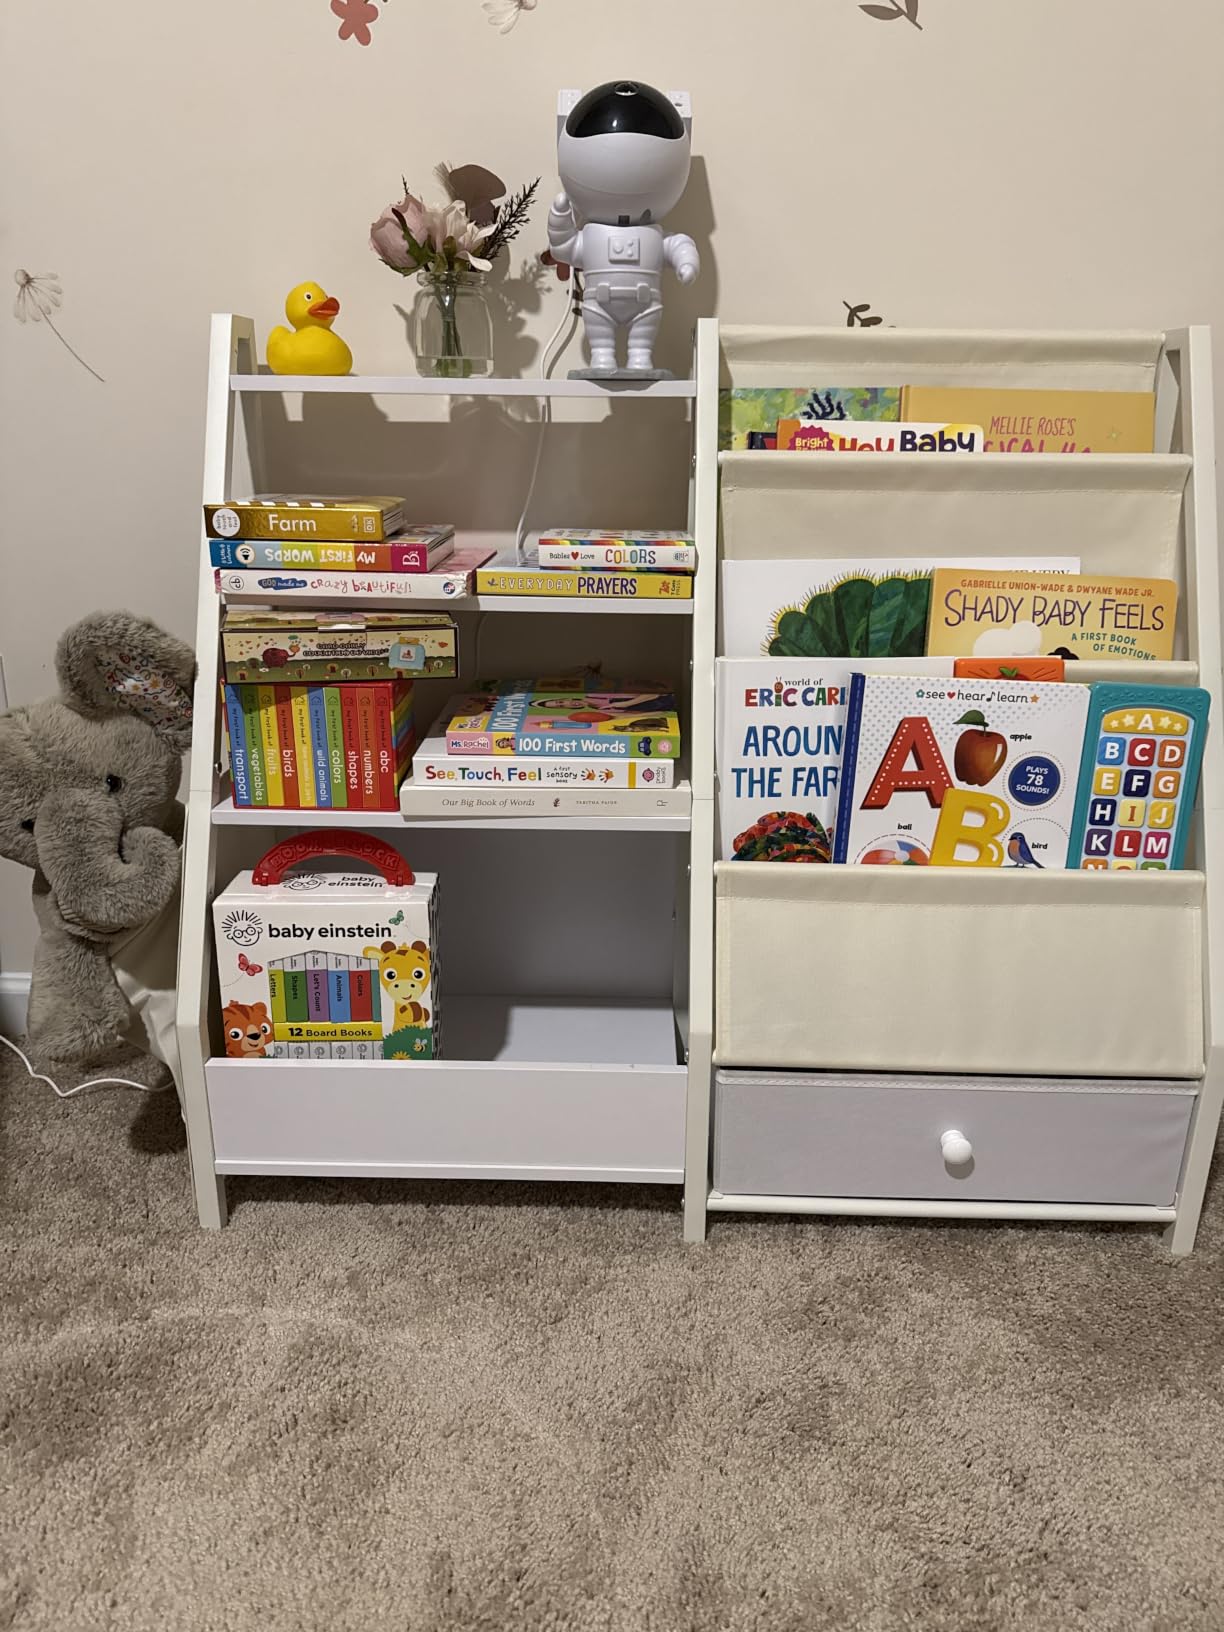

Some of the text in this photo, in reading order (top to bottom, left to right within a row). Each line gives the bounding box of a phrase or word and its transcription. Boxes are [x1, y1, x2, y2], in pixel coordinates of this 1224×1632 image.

[989, 416, 1077, 436] MELLIE ROSE'S
[795, 437, 828, 448] Bright
[268, 513, 317, 532] Farm
[264, 548, 315, 563] WORDS
[580, 552, 595, 560] Love
[605, 549, 656, 564] COLORS
[499, 576, 638, 595] EVERYDAY PRAYERS
[960, 579, 1007, 590] GABRIELLE
[1008, 582, 1064, 593] UNION-WADE
[1076, 585, 1113, 595] DWYANE
[1115, 587, 1139, 596] WADE
[1140, 589, 1155, 597] JR.
[944, 588, 1165, 631] SHADY BABY FEELS
[1071, 633, 1137, 646] A FIRST BOOK
[1093, 643, 1156, 660] OF EMOTIONS
[785, 678, 823, 686] world of
[925, 690, 1028, 703] see hear learn
[1137, 714, 1155, 730] A
[463, 740, 489, 749] Rachel
[519, 738, 625, 754] 100 First Words
[742, 725, 843, 757] AROUN
[1009, 733, 1032, 742] apple
[316, 749, 326, 767] wild
[380, 750, 391, 773] abc
[1105, 742, 1181, 763] B C D
[267, 748, 276, 776] fruits
[282, 749, 295, 777] birds
[331, 749, 343, 784] colors
[347, 751, 359, 790] shapes
[860, 716, 954, 810] A
[1025, 766, 1048, 775] PLAYS
[235, 749, 249, 799] transport
[251, 747, 264, 801] vegetables
[363, 750, 375, 795] numbers
[425, 765, 542, 782] See, Touch, Feel
[1026, 774, 1044, 786] 78
[318, 769, 328, 801] animals
[731, 766, 839, 798] THE FAR
[1016, 785, 1050, 794] SOUNDS!
[1101, 772, 1175, 793] E F G
[441, 798, 535, 808] Our Big Book of Words
[1094, 803, 1168, 824] H I J
[897, 823, 912, 831] ball
[928, 787, 1011, 866] B
[1031, 842, 1048, 850] bird
[1090, 834, 1168, 854] K L M
[268, 923, 392, 940] baby einstein
[288, 1027, 373, 1037] 12 Board Books
